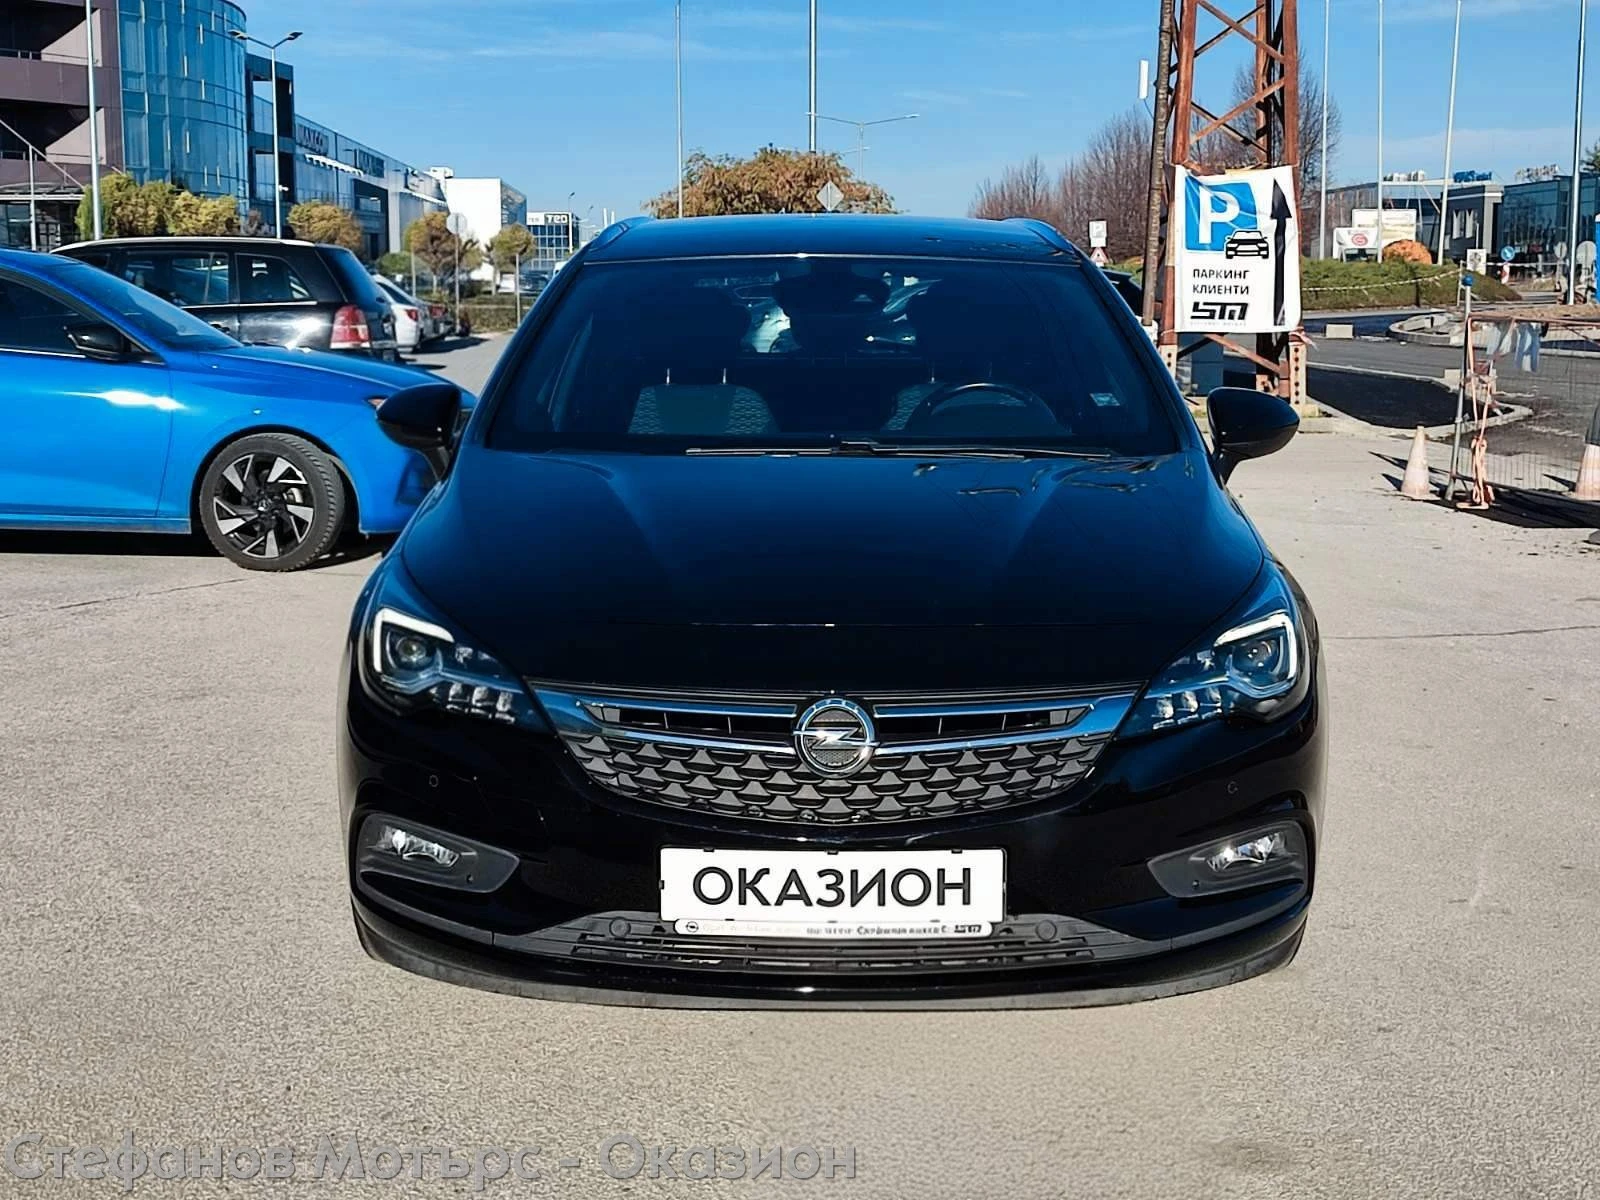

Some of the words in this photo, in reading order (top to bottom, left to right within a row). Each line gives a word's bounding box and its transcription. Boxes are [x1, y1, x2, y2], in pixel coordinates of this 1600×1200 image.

[1199, 186, 1240, 244] P
[1192, 268, 1250, 280] ПАРКИНГ
[1192, 284, 1250, 296] КЛИЕНТИ
[692, 866, 971, 907] ОКАЗИОН
